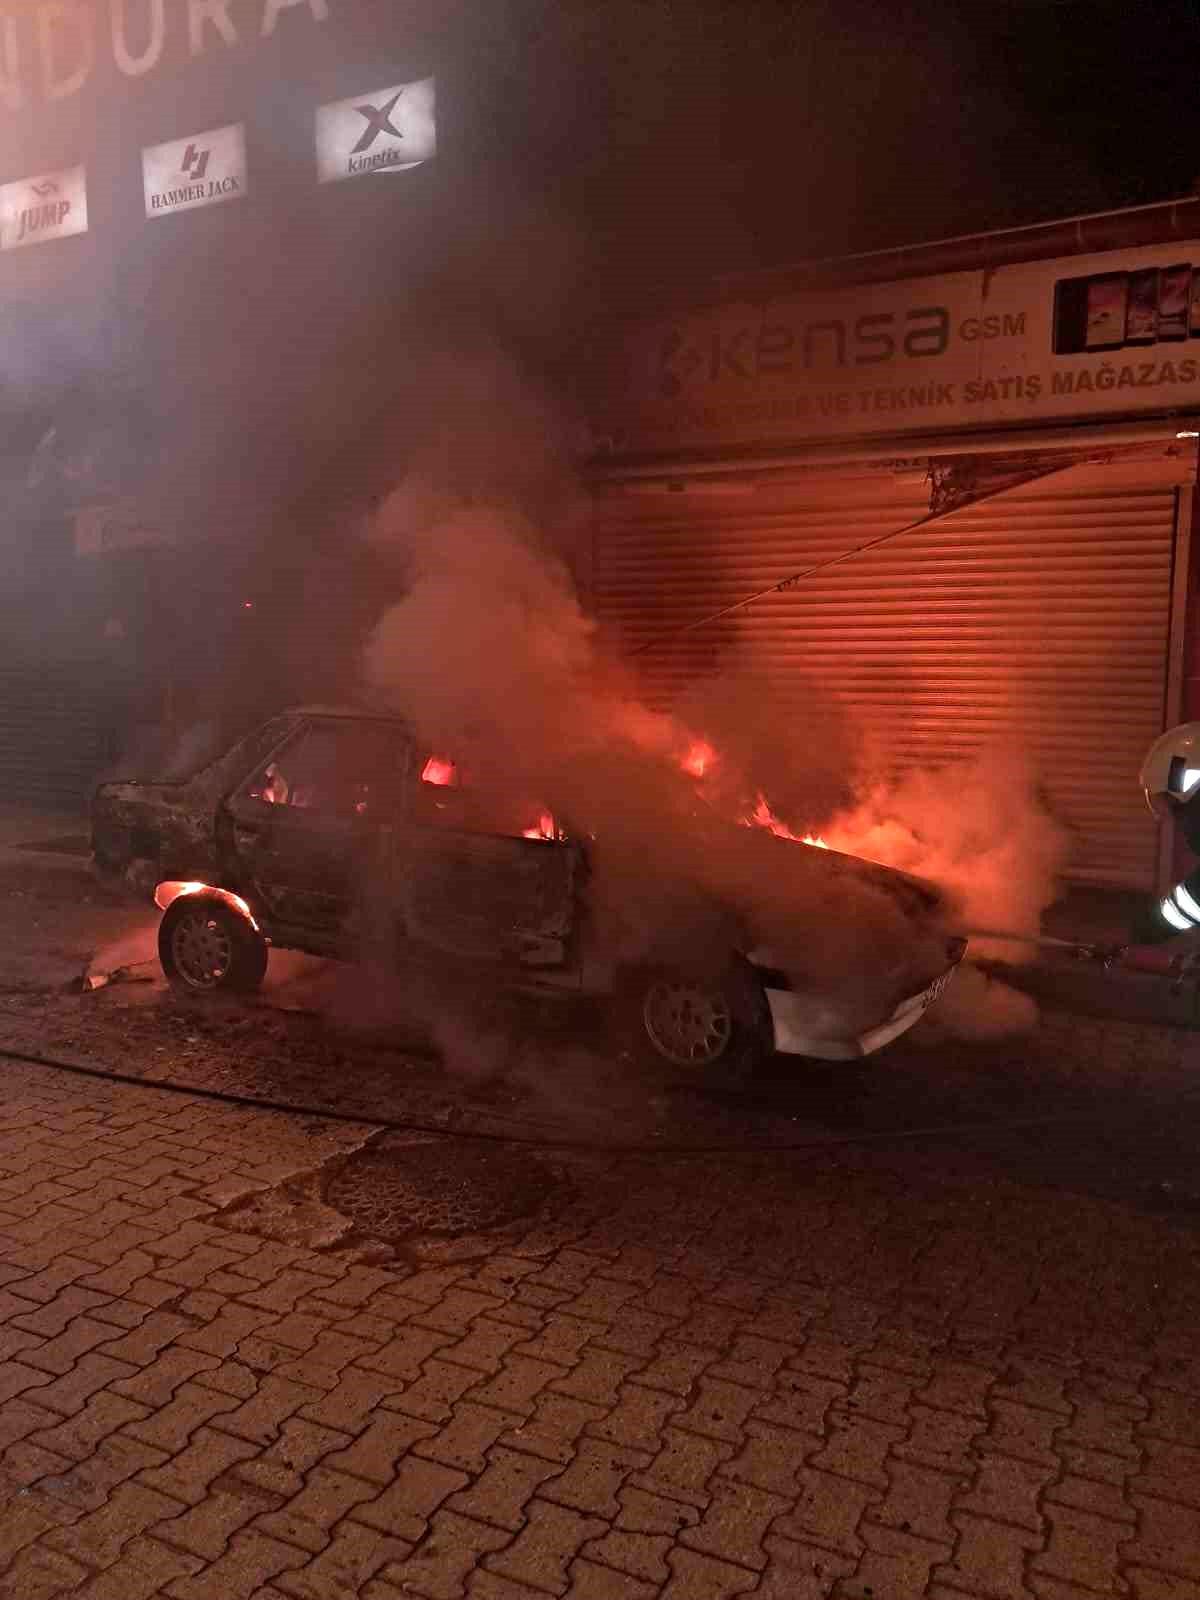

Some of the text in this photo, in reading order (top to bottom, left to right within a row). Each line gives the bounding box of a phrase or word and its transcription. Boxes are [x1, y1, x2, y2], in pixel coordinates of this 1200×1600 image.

[347, 148, 401, 172] kinetix
[152, 176, 241, 208] HAMMER JACK
[18, 200, 70, 240] JUMP
[959, 312, 1026, 343] GSM
[821, 391, 854, 416] VE
[858, 379, 955, 411] TEKNİK
[964, 373, 1042, 404] SATIŞ
